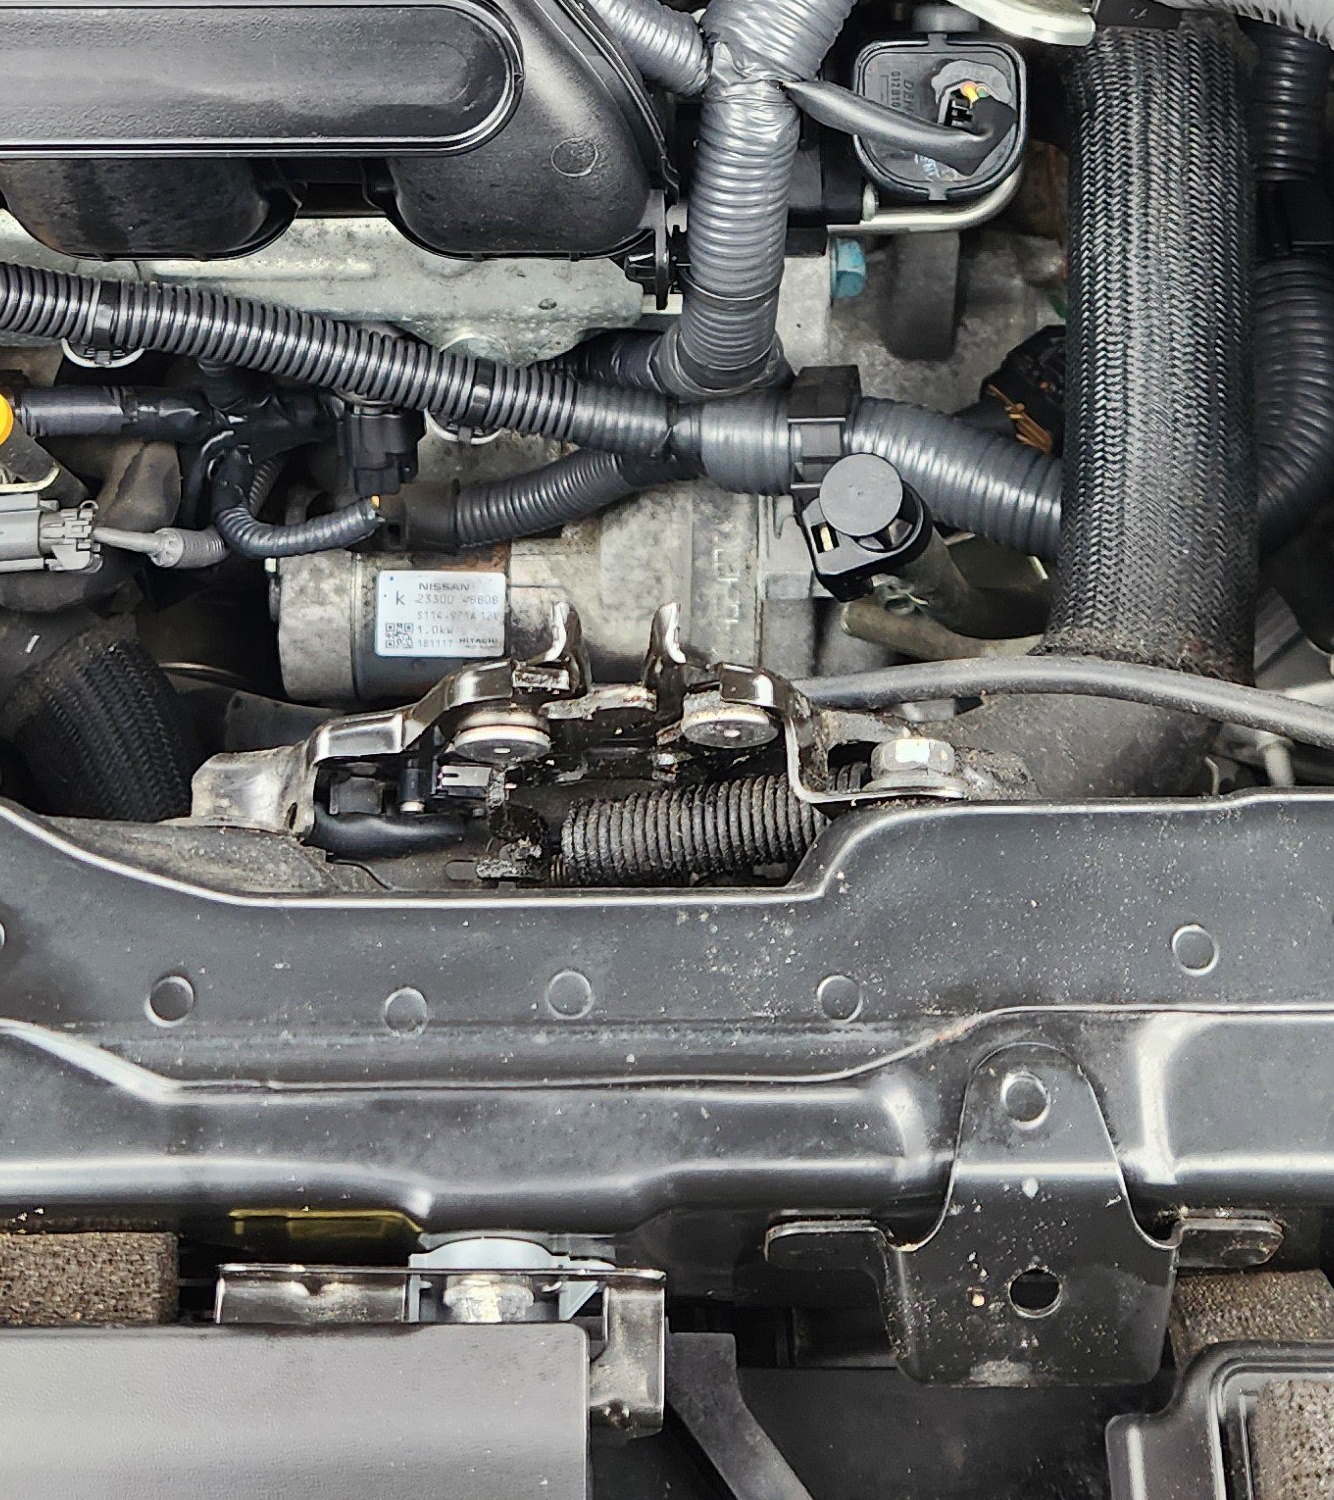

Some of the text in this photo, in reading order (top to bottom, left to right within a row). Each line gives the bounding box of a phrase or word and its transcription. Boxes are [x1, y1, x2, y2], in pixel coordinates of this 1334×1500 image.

[902, 78, 915, 113] DEN
[418, 582, 470, 591] NISSAN
[458, 637, 498, 645] HITACHI
